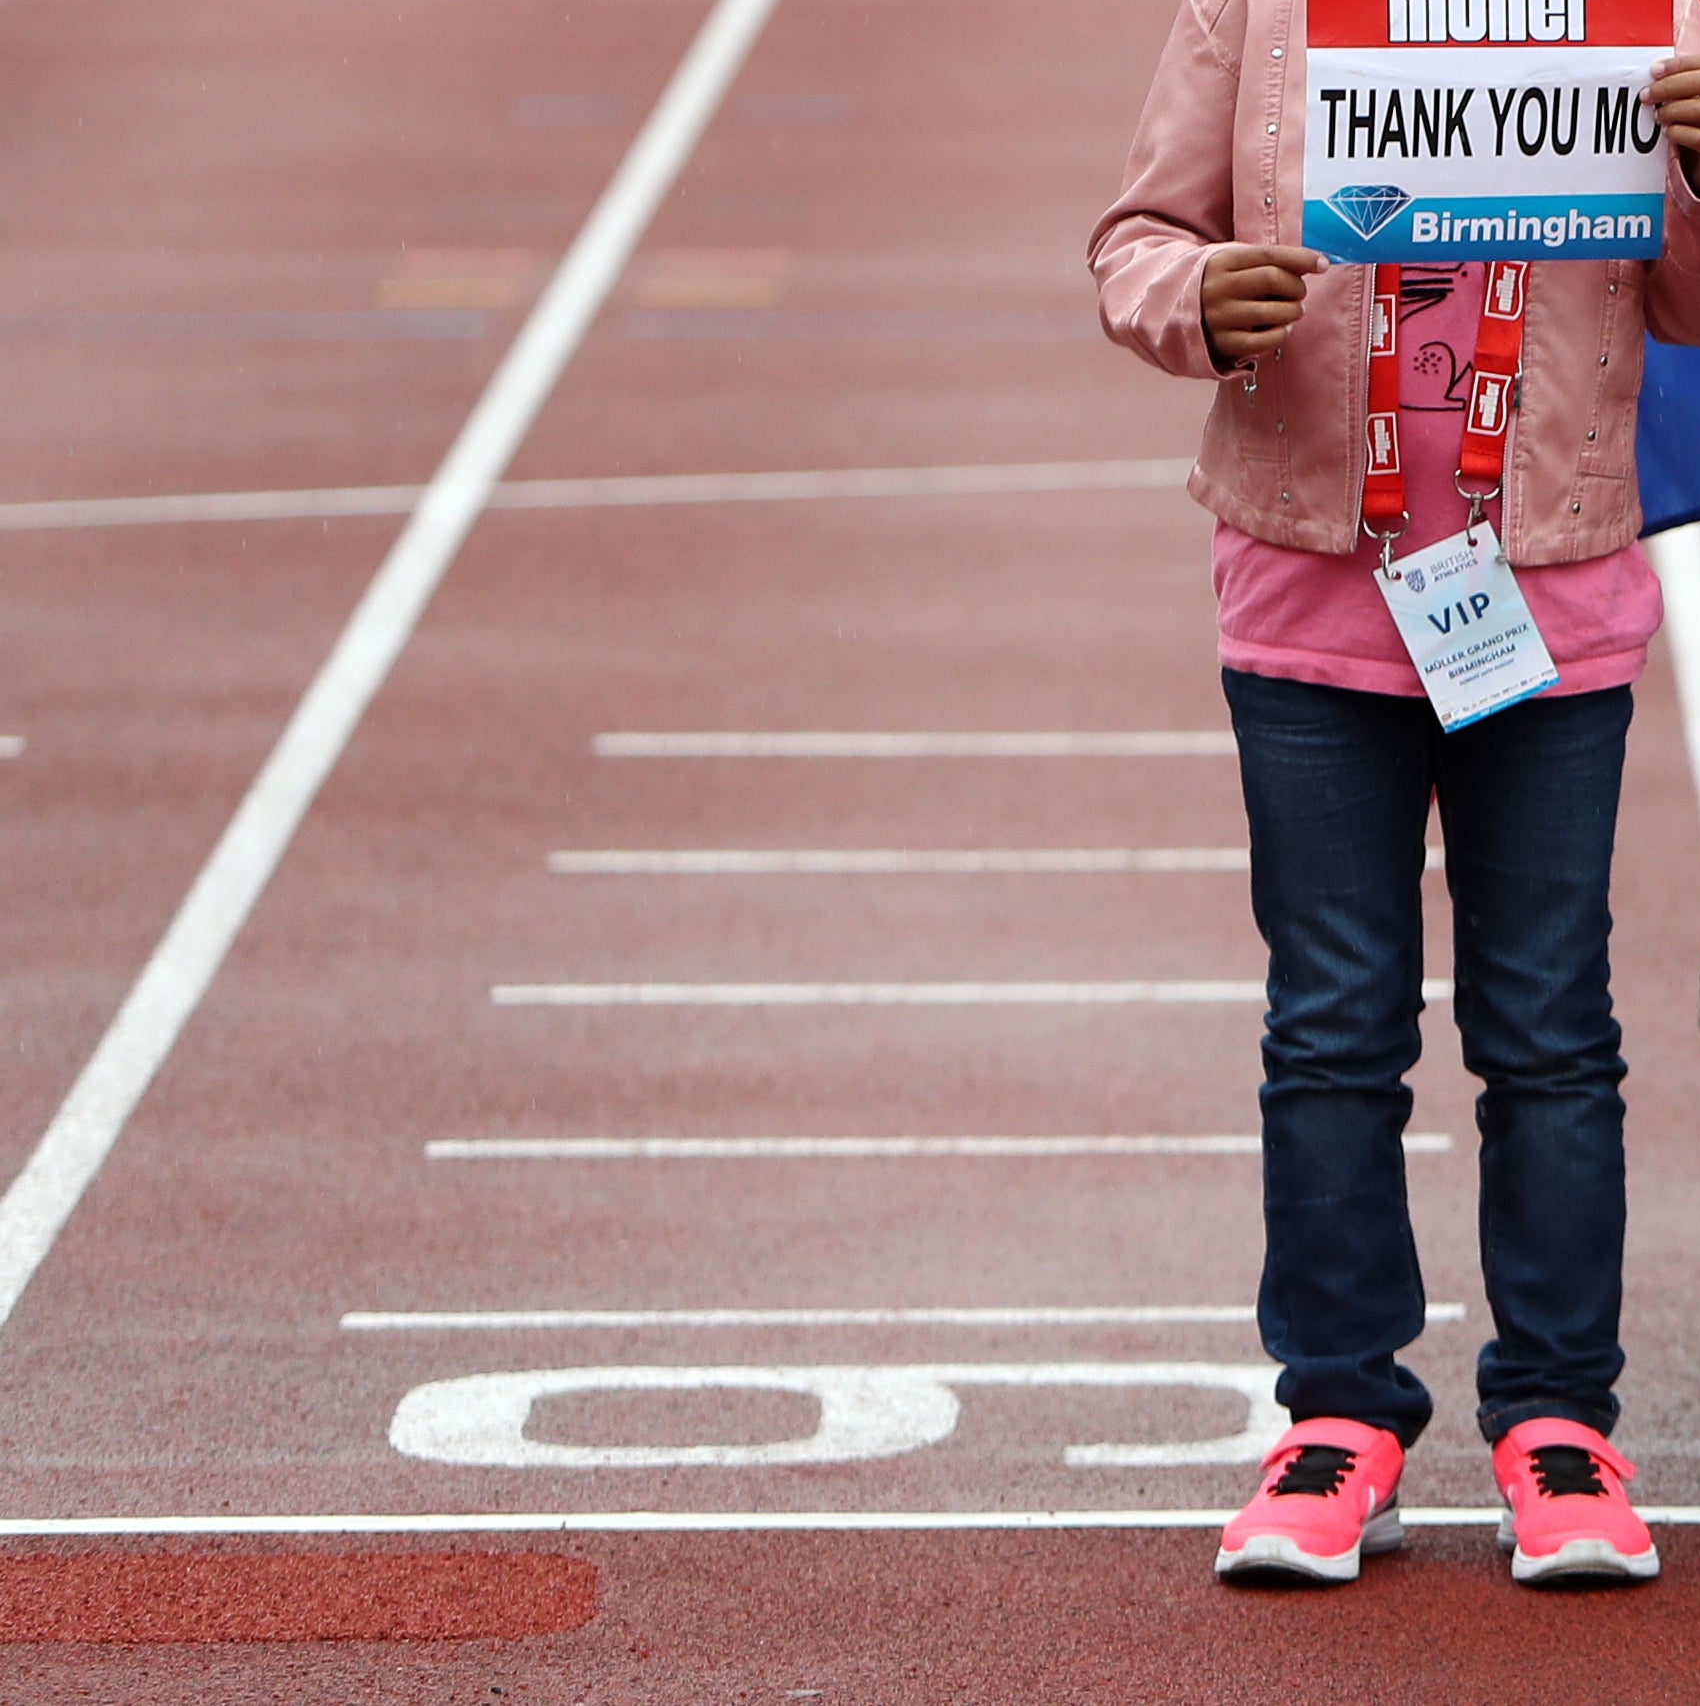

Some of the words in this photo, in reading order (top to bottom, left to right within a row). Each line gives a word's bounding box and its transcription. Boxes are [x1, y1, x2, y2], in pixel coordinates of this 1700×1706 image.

[1320, 88, 1474, 160] THANK
[1488, 87, 1580, 157] YOU
[1594, 86, 1662, 154] MO
[1410, 207, 1653, 247] Birmingham
[1427, 591, 1491, 635] VIP
[1466, 635, 1504, 659] GRAND
[1504, 622, 1530, 643] PRIX
[1448, 643, 1517, 680] BIRMINGHAM
